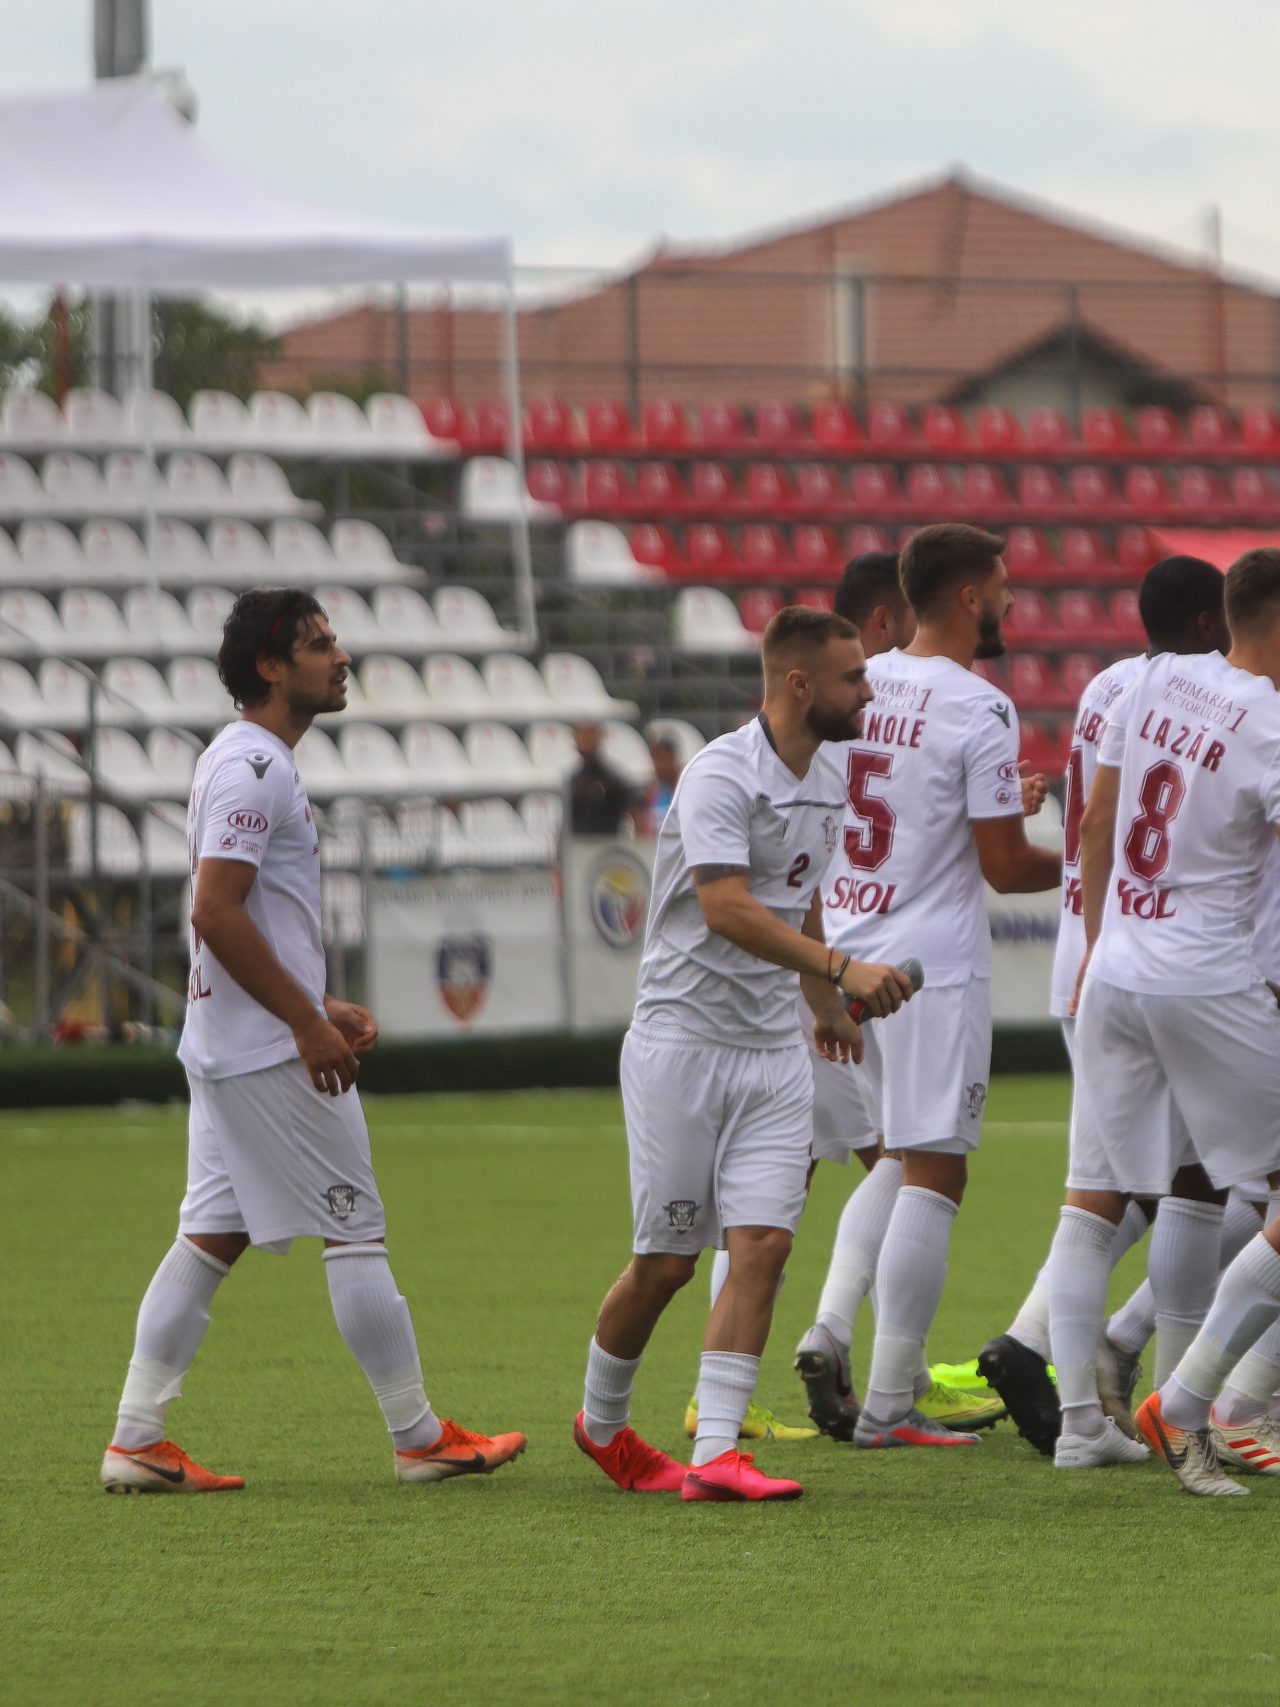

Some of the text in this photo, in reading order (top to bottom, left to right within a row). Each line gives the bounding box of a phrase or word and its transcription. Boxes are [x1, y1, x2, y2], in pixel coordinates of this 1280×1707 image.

[916, 687, 934, 712] 1
[1167, 674, 1234, 713] PRIMARIA
[1227, 707, 1249, 734] 1
[1139, 708, 1227, 773] LAZĂR
[235, 812, 262, 830] KIA
[843, 746, 897, 873] 5
[1124, 758, 1188, 884] 8
[786, 852, 811, 888] 2
[1117, 877, 1179, 920] KOL
